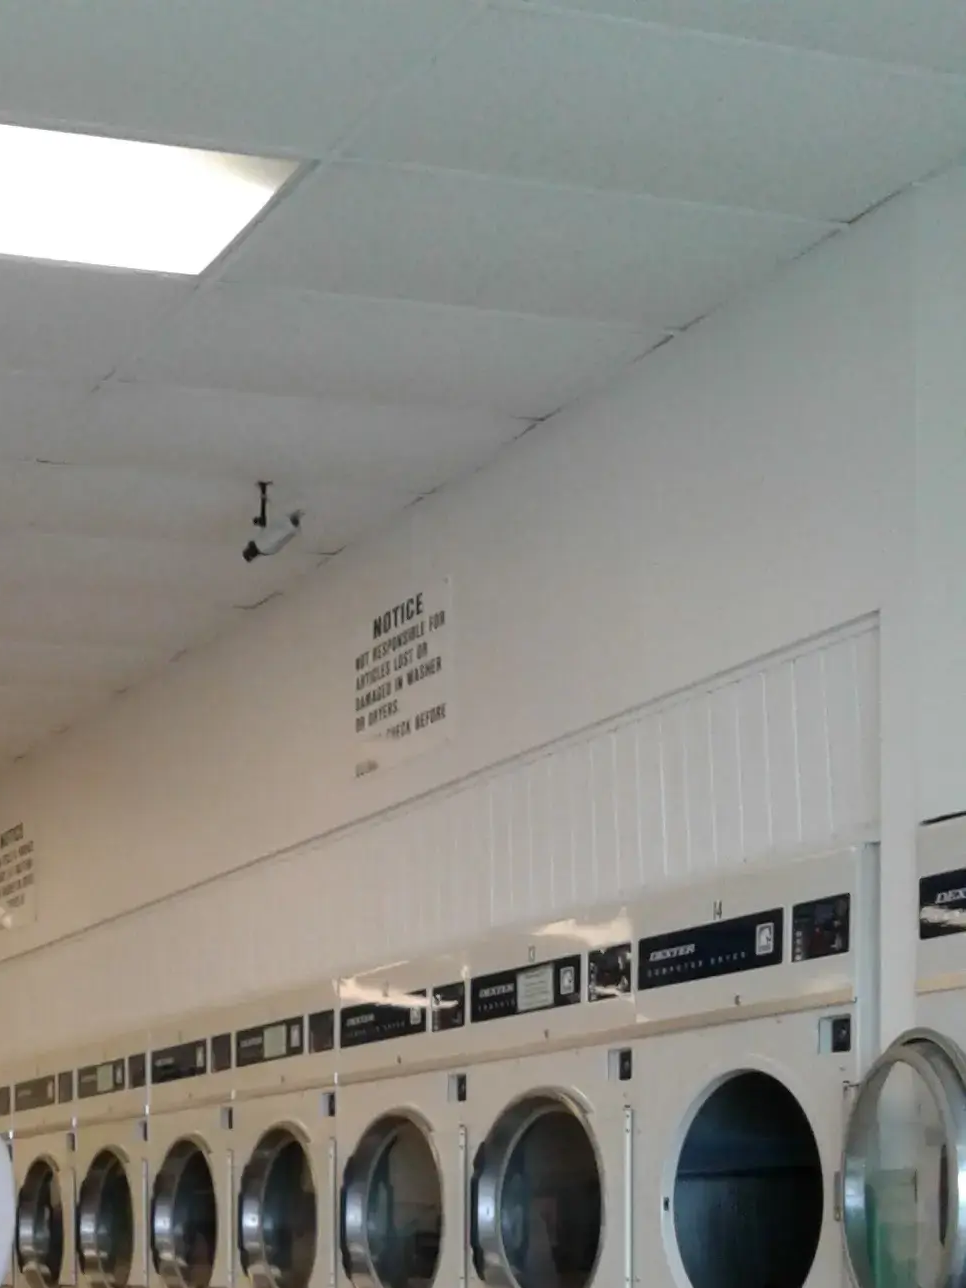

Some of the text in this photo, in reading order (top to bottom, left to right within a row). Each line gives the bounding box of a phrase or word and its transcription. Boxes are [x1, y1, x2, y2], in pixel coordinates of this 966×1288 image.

[373, 591, 423, 640] NOTICE
[355, 610, 446, 671] NOT RESPONSIBLE FOR
[355, 641, 428, 691] ARTICLES LOST OR
[355, 656, 442, 712] DAMAGED IN WASHER
[355, 698, 398, 733] OR DRYERS
[415, 702, 447, 731] BEFORE
[649, 943, 696, 962] DEXTER
[478, 983, 515, 999] DEXTER
